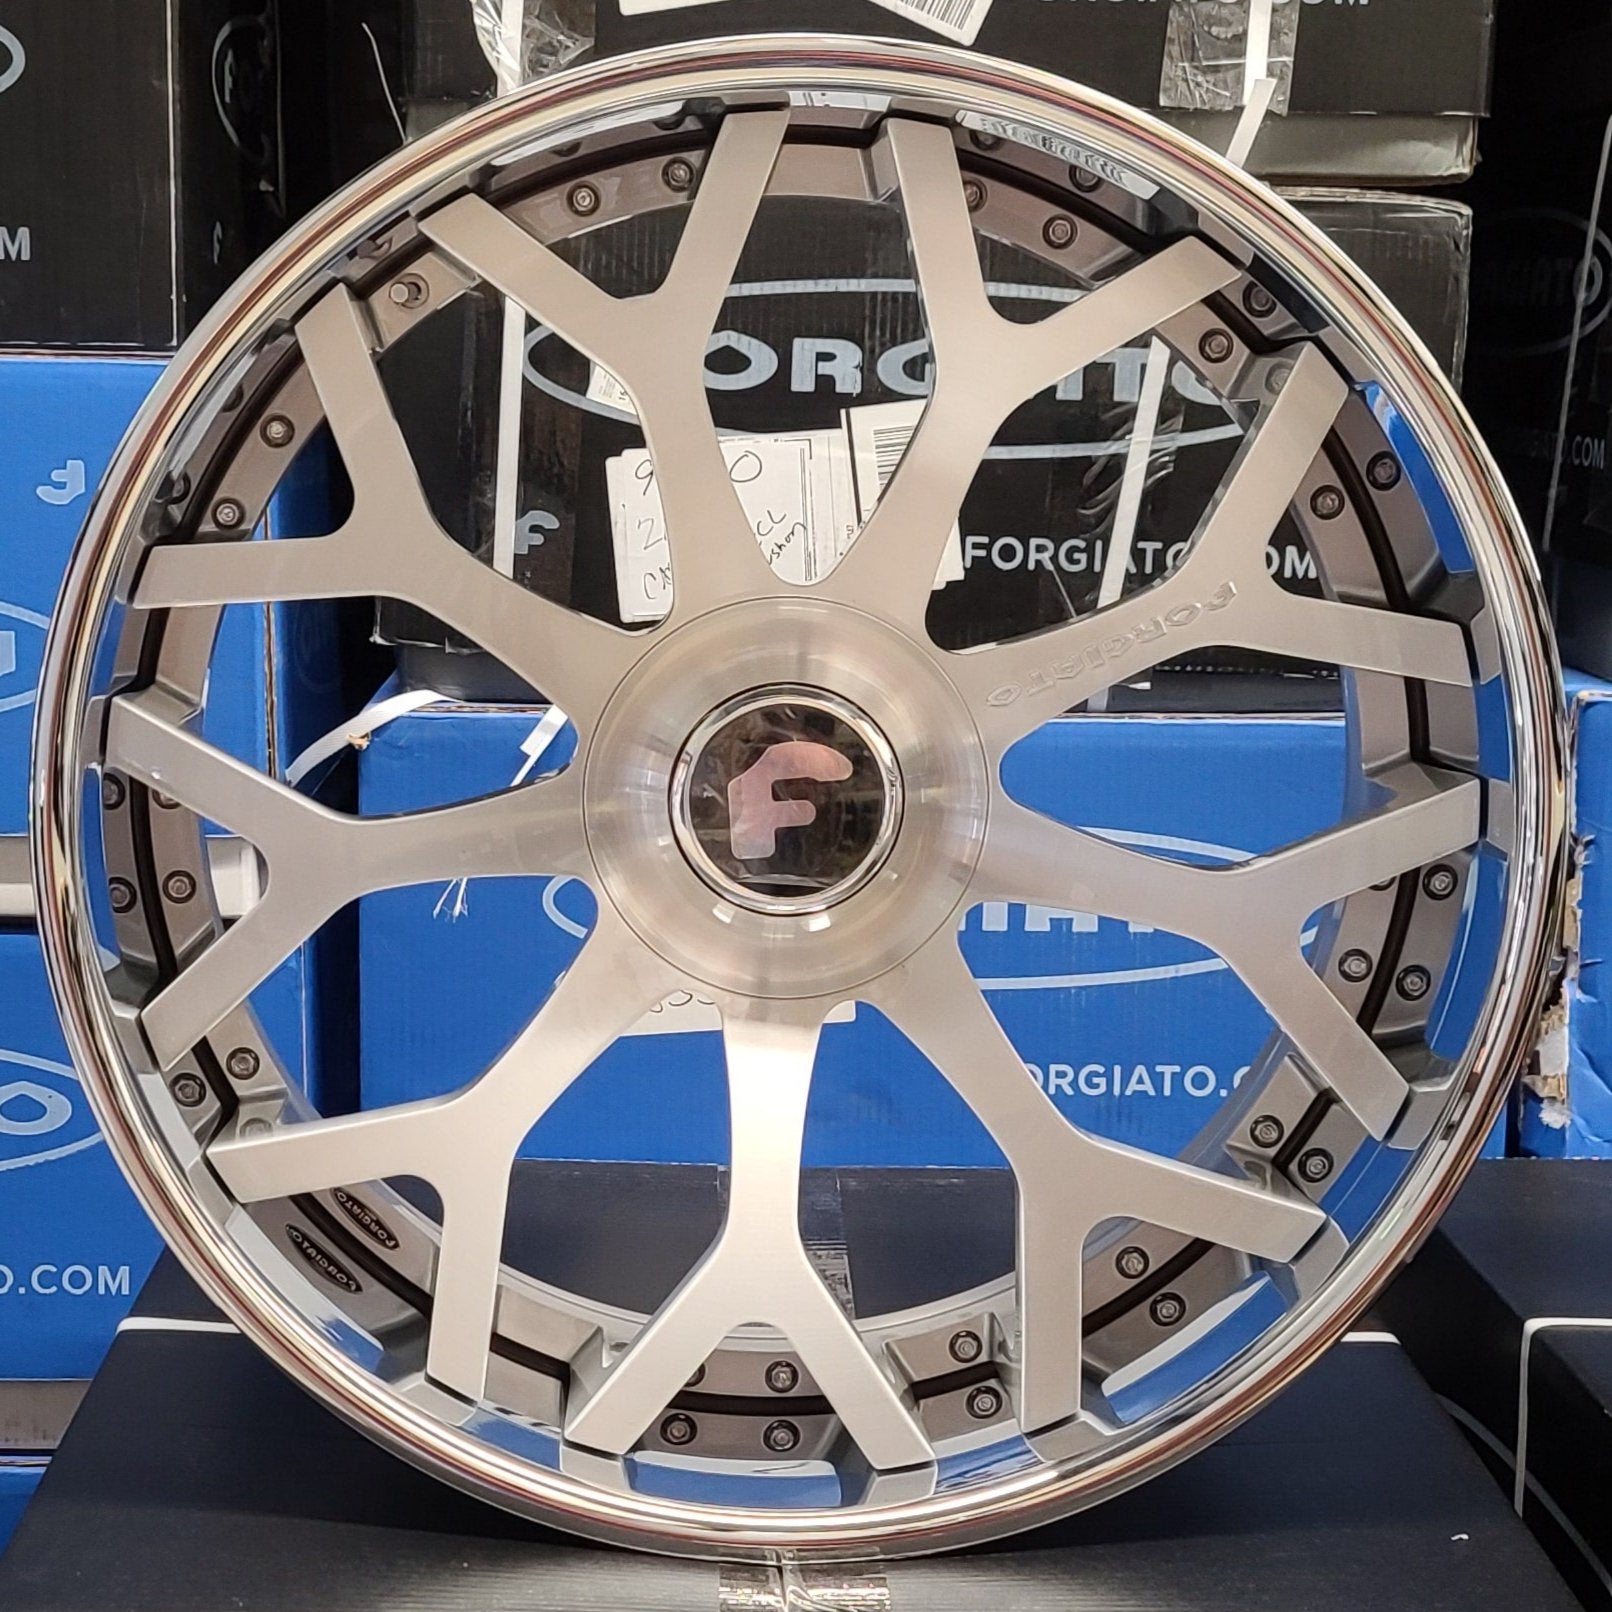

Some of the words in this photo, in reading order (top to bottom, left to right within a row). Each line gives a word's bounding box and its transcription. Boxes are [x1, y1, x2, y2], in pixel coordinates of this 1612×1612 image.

[986, 581, 1238, 707] FORGIATO
[727, 741, 853, 860] F
[337, 1191, 396, 1248] FORGIATO
